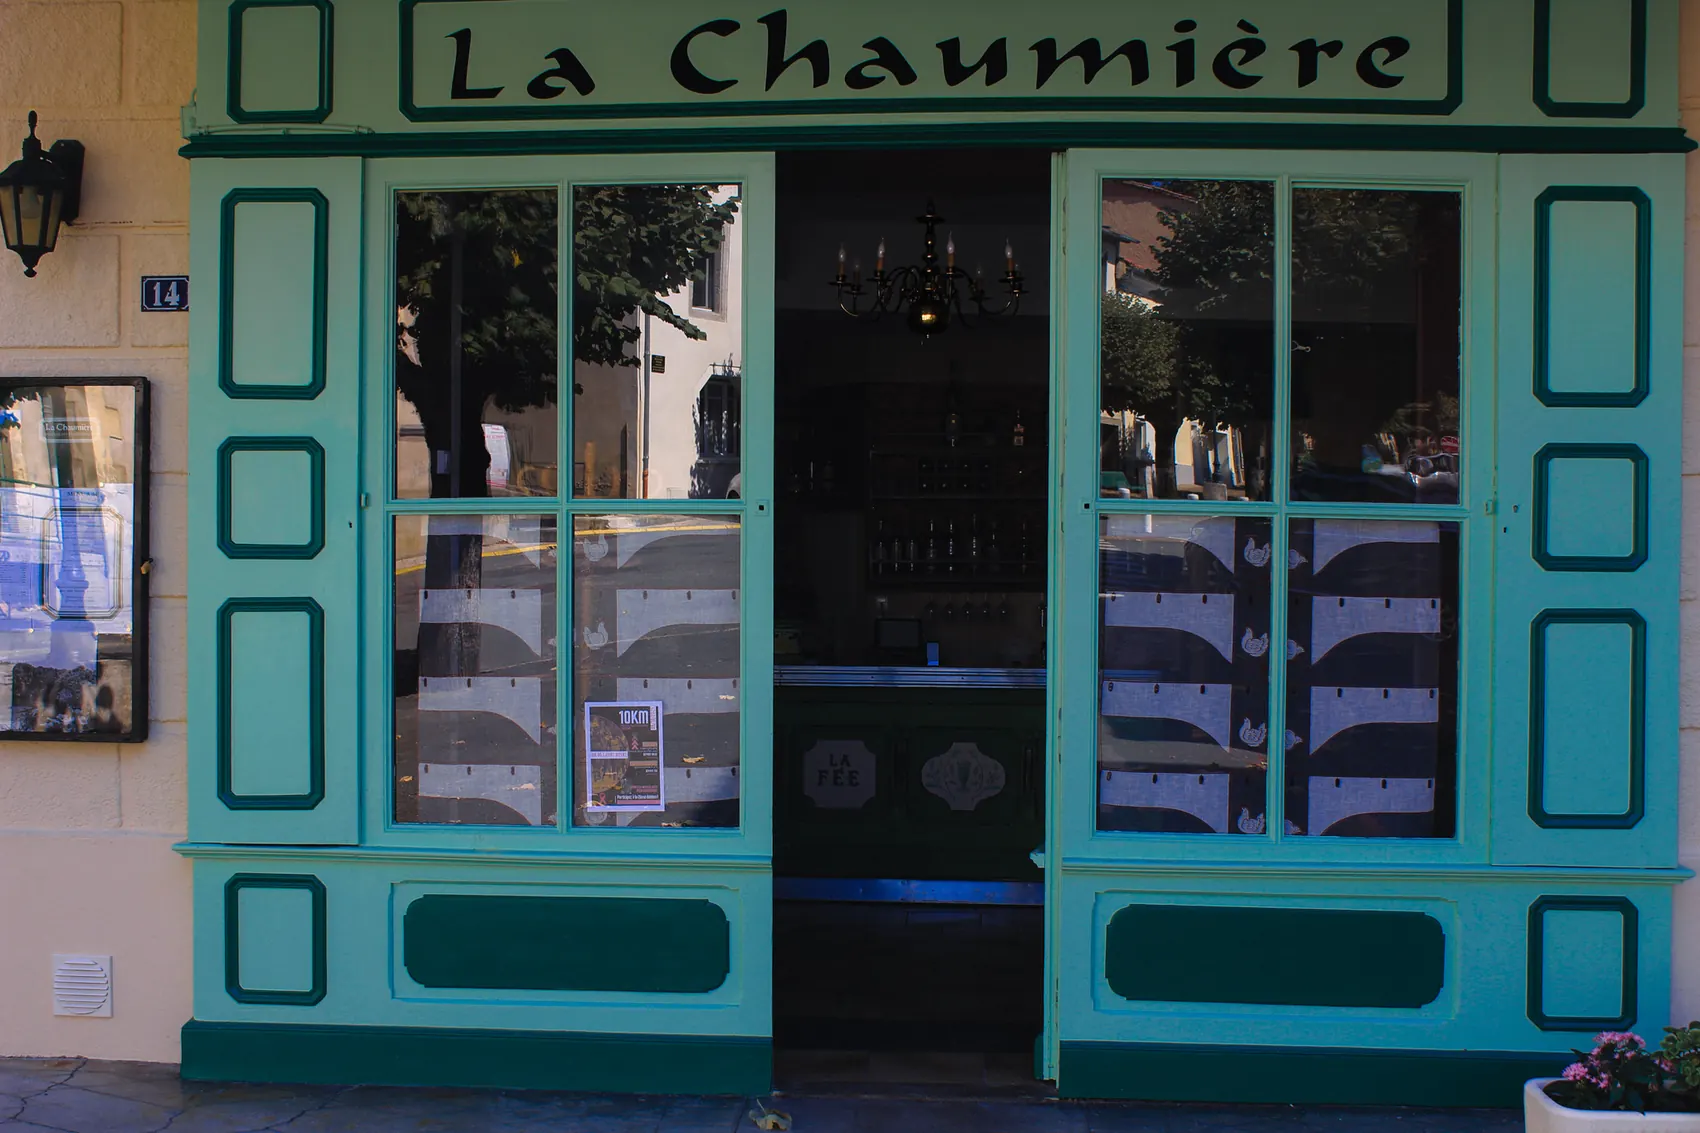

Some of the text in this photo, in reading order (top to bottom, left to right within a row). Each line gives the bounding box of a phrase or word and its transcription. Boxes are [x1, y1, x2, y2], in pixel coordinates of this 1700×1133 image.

[445, 9, 1411, 99] La Chaumière
[153, 281, 180, 306] 14
[829, 753, 851, 767] LA
[817, 767, 860, 787] FÉE
